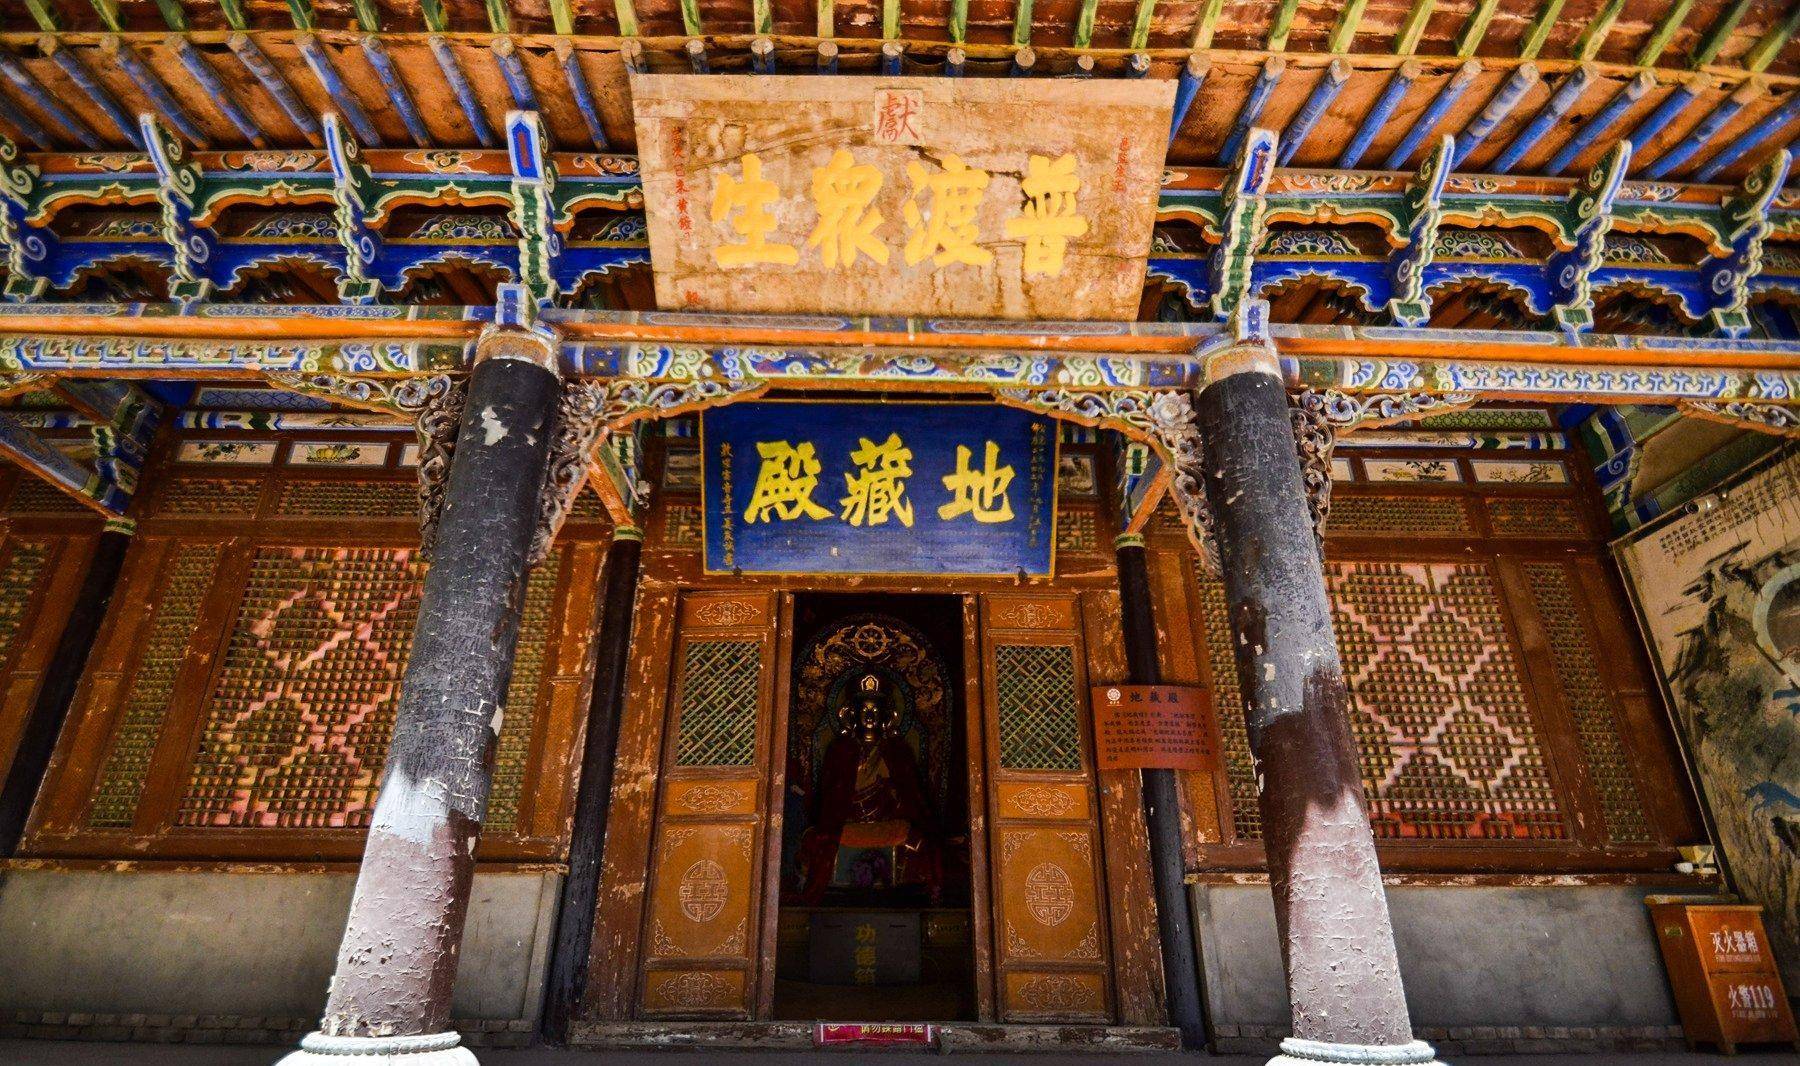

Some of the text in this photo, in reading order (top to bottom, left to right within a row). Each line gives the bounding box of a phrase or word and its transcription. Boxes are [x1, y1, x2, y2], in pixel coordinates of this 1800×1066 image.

[744, 433, 1016, 528] 地藏殿
[1710, 928, 1758, 953] 灭火器箱
[1728, 985, 1774, 1008] 火警119
